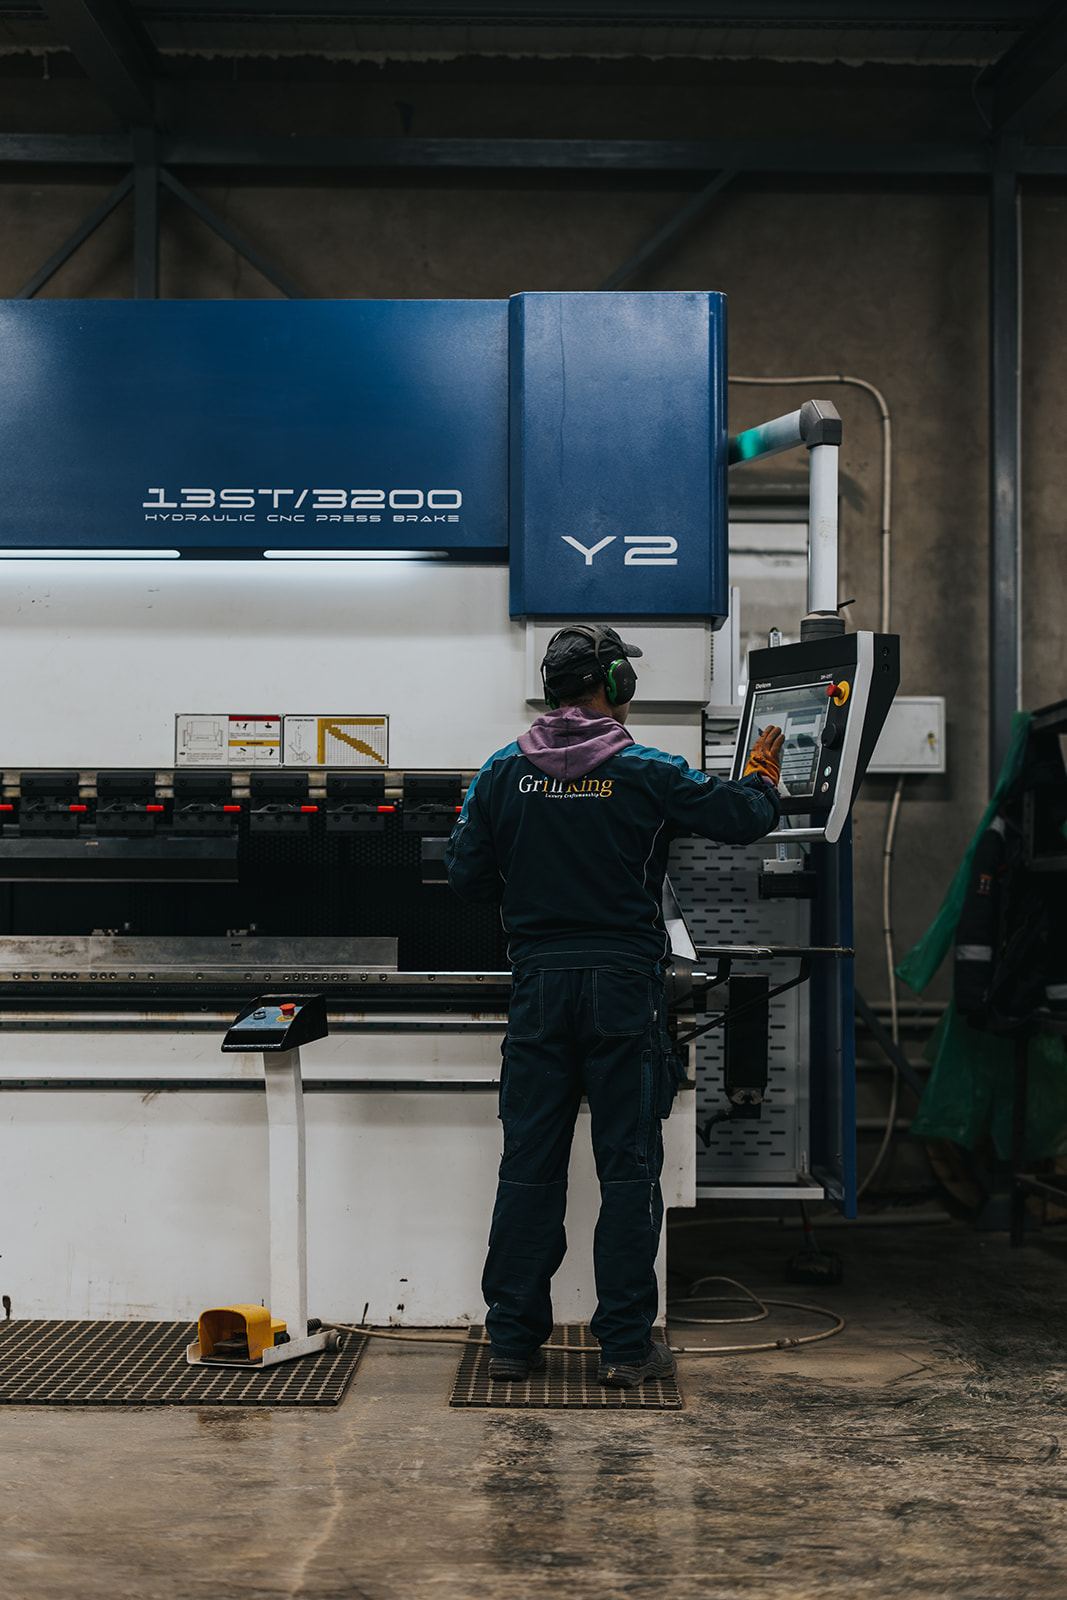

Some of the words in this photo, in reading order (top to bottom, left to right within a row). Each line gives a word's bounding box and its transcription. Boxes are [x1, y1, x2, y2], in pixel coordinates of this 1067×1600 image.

[142, 488, 463, 509] 13ST/3200
[144, 514, 256, 522] HYDRAULIC
[266, 514, 306, 522] CNC
[315, 514, 382, 523] PRESS
[392, 514, 460, 523] BRAKE
[560, 535, 679, 566] Y2
